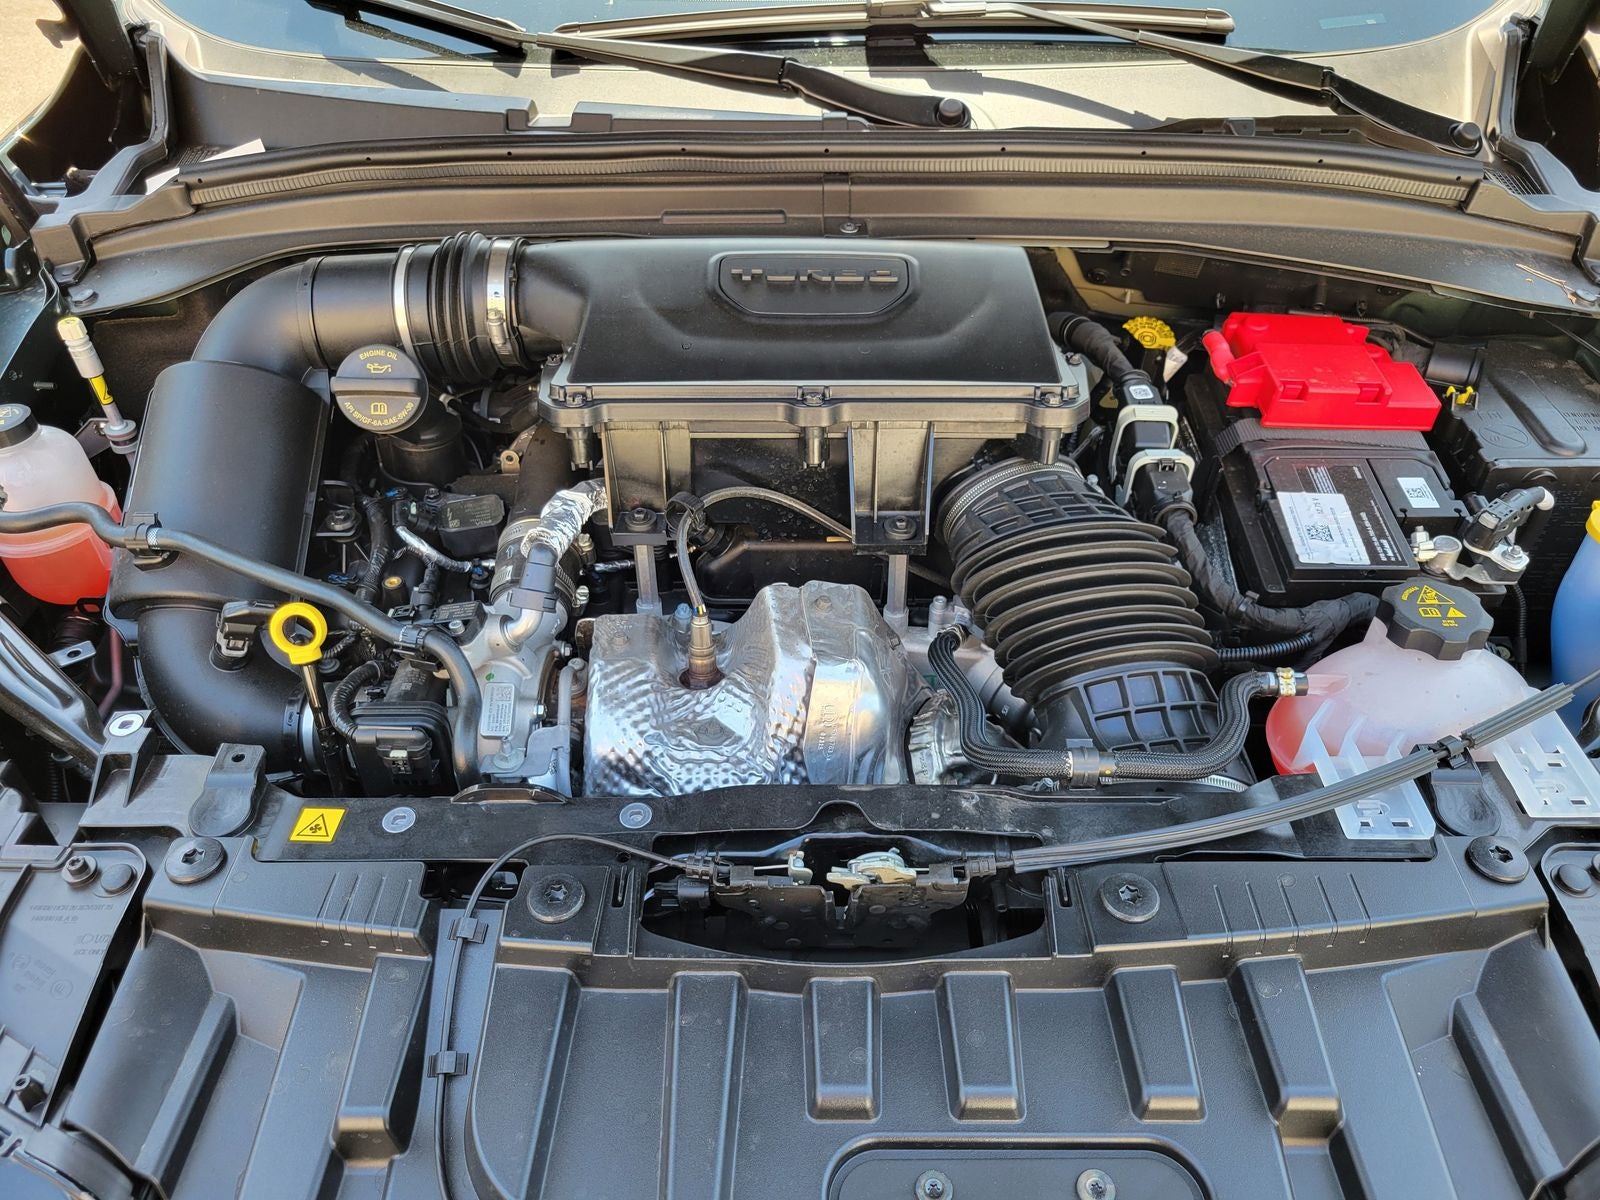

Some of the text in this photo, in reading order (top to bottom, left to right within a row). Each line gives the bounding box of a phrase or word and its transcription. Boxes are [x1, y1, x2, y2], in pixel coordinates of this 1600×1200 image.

[359, 349, 398, 360] ENGINE OIL
[344, 402, 355, 413] API
